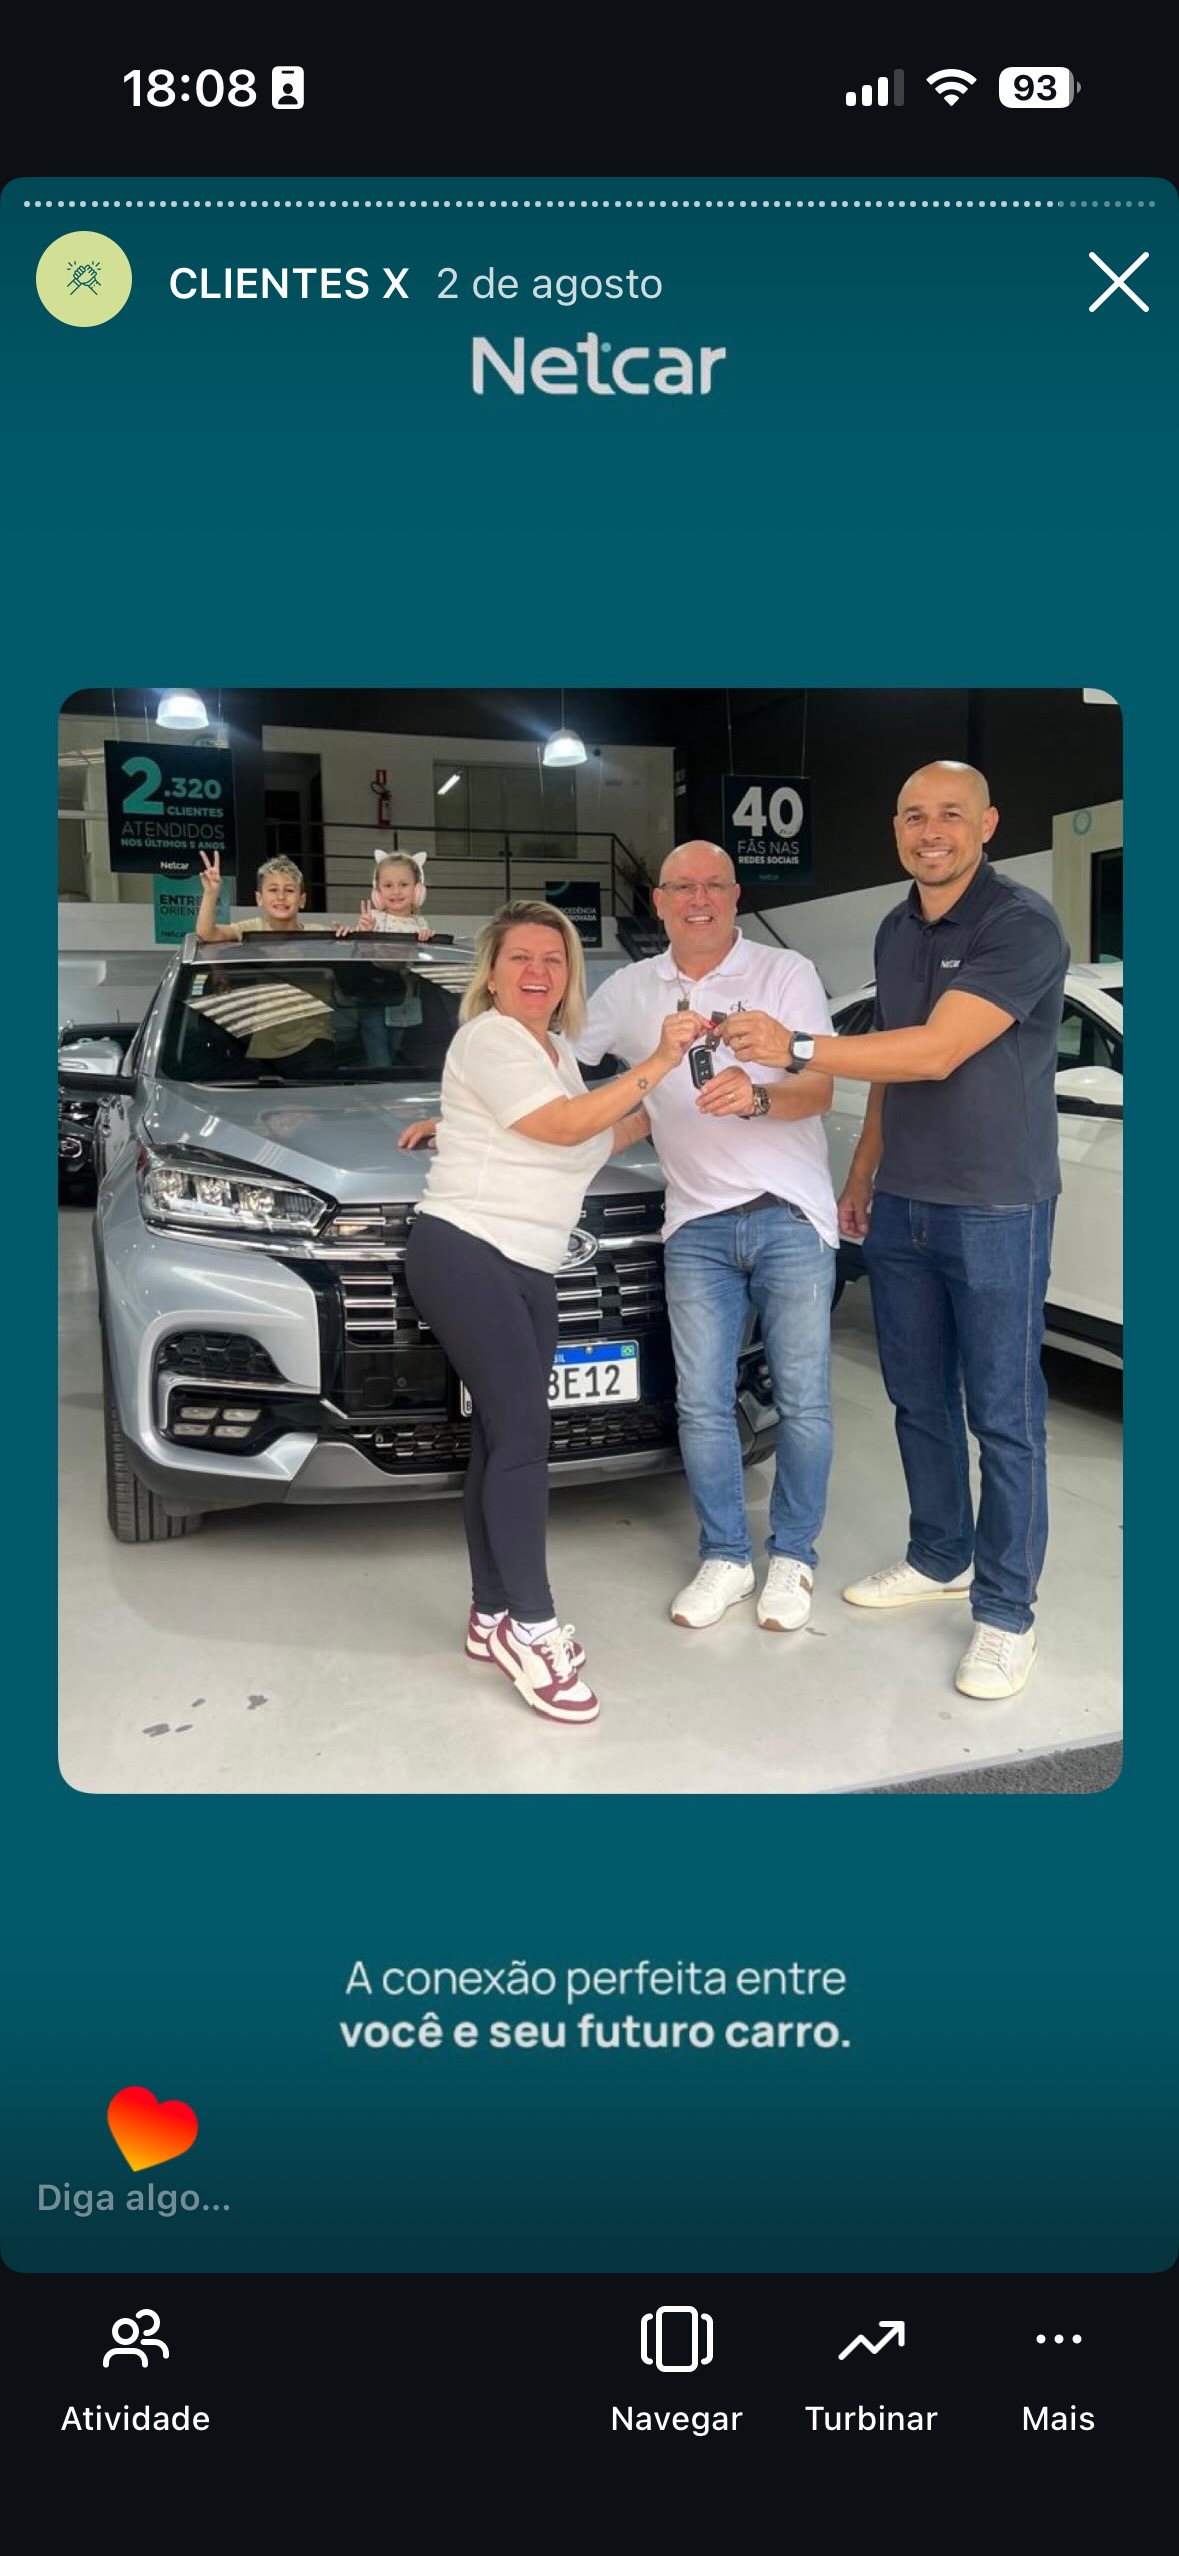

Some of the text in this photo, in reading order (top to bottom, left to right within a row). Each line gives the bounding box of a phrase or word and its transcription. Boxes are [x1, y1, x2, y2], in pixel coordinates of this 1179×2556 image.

[166, 805, 224, 817] CLIENTES
[731, 786, 804, 838] 40
[121, 820, 225, 839] ATENDIDOS
[121, 838, 142, 848] NOS
[198, 841, 225, 850] ANOS
[737, 839, 799, 855] FÃS NAS
[738, 855, 799, 865] REDES SOCIAIS
